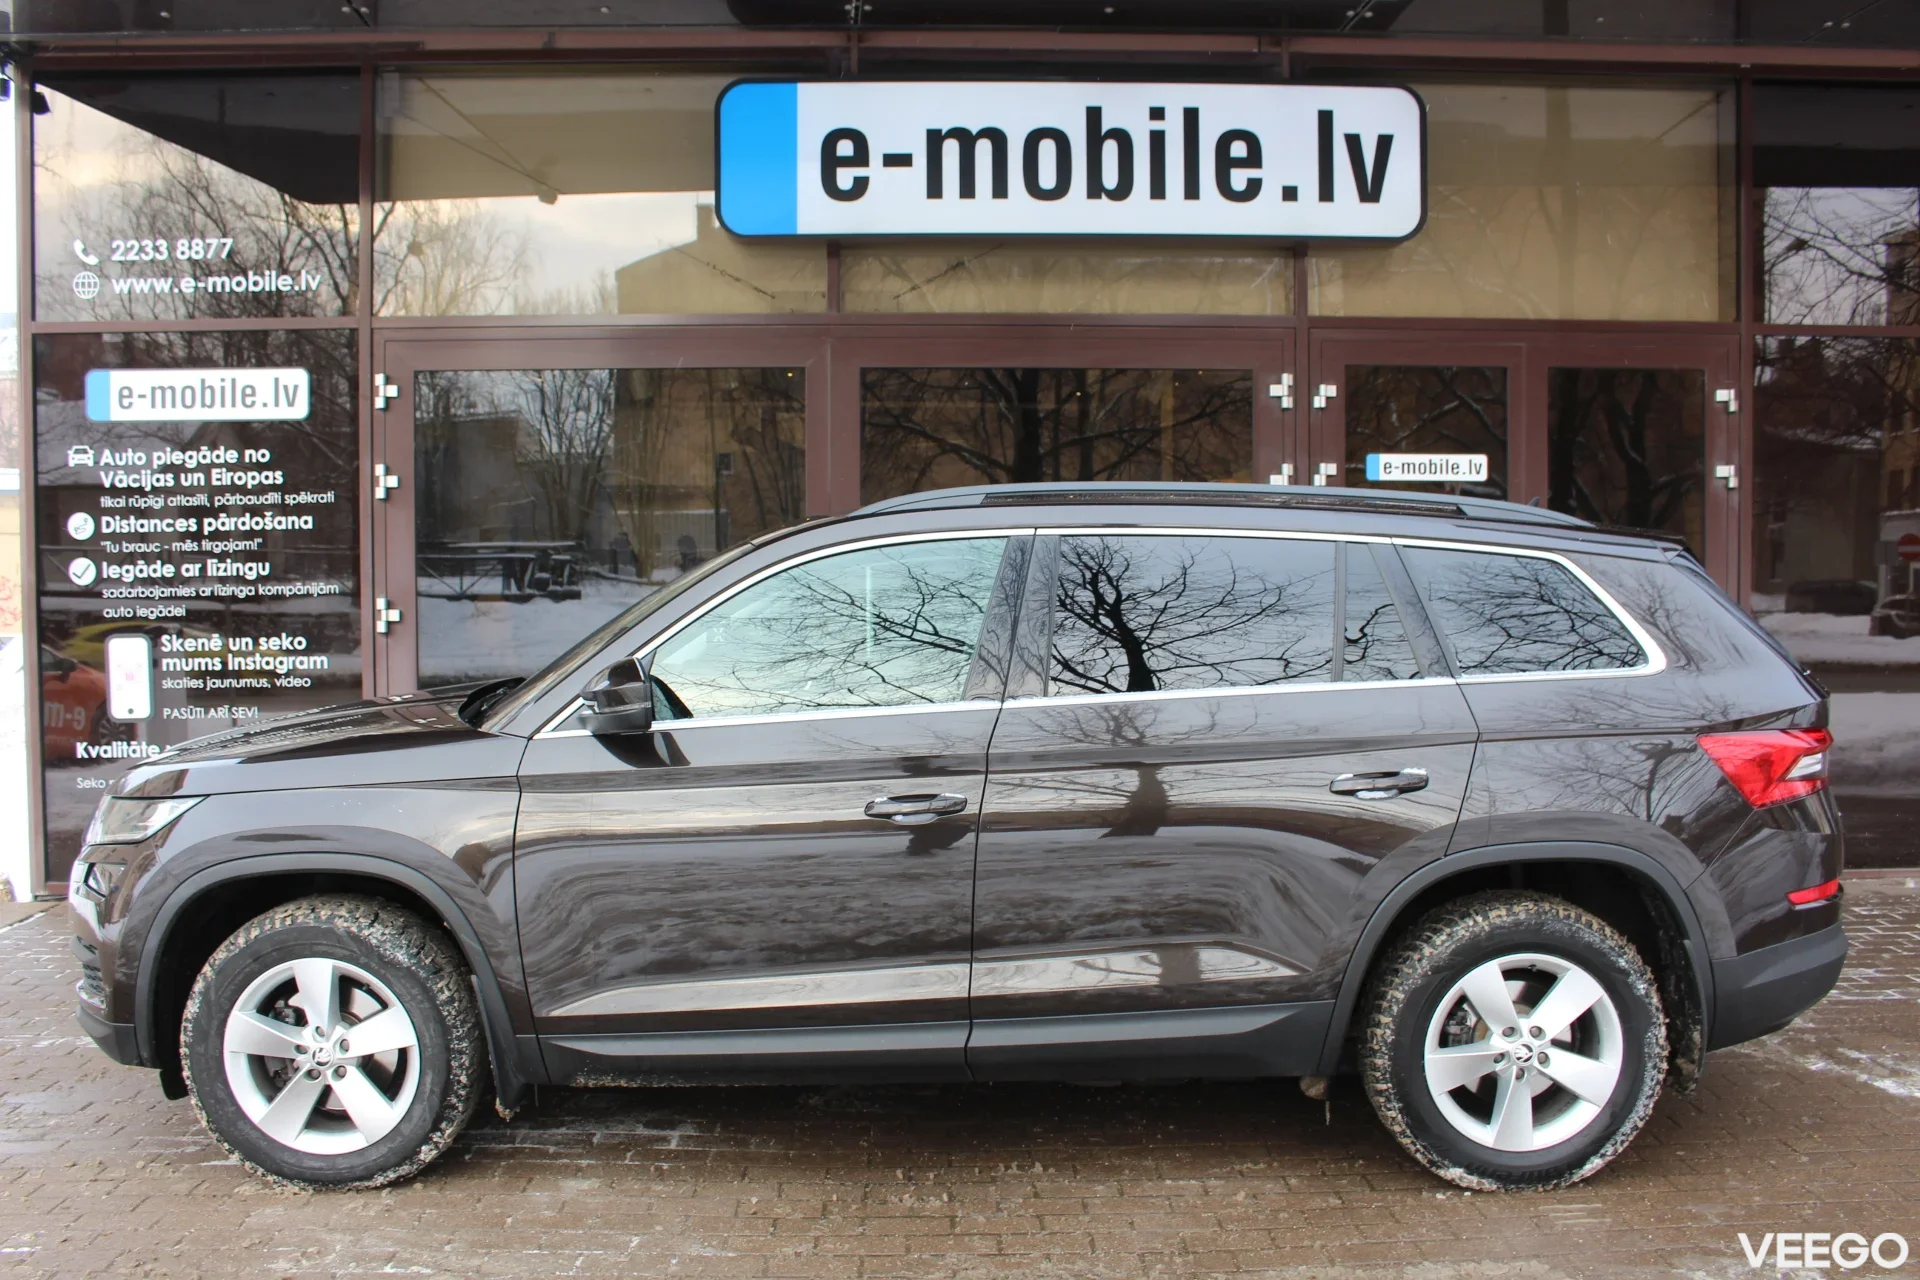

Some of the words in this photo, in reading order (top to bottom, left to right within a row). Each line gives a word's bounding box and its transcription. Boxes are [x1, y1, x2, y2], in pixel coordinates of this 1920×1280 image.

[819, 105, 1394, 203] e-mobile.lv
[111, 240, 168, 262] 2233
[176, 238, 233, 260] 8877
[111, 270, 322, 295] www.e-mobile.lv
[117, 376, 300, 410] e-mobile.lv
[100, 448, 147, 466] Auto
[152, 446, 238, 469] piegāde
[244, 448, 271, 463] no
[1383, 459, 1483, 475] e-mobile.lv
[99, 470, 175, 492] Vācijas
[180, 471, 205, 486] un
[211, 468, 284, 489] Eiropas
[100, 495, 126, 508] tikai
[128, 494, 165, 510] rūpīgi
[214, 491, 282, 508] pārbaudīti
[284, 490, 335, 506] spēkrati
[101, 515, 198, 534] Distances
[203, 511, 314, 536] pārdošana
[122, 540, 161, 553] brauc
[171, 540, 199, 552] mēs
[102, 560, 176, 583] Iegāde
[180, 563, 202, 578] ar
[206, 558, 271, 581] līzingu
[102, 585, 197, 601] sadarbojamies
[199, 586, 213, 597] ar
[214, 583, 256, 599] līzinga
[258, 582, 340, 598] kompānijām
[103, 606, 134, 618] auto
[136, 604, 186, 620] iegādei
[161, 633, 223, 652] Skenē
[229, 637, 253, 650] un
[258, 632, 307, 650] seko
[161, 656, 222, 671] mums
[228, 653, 329, 674] Instagram
[161, 676, 204, 689] skaties
[206, 676, 271, 691] jaunumus,
[274, 676, 312, 688] video
[163, 705, 205, 720] PASŪTI
[207, 704, 230, 719] ARĪ
[231, 706, 259, 719] SEV!
[75, 741, 160, 759] Kvalitāte
[76, 777, 106, 789] Seko
